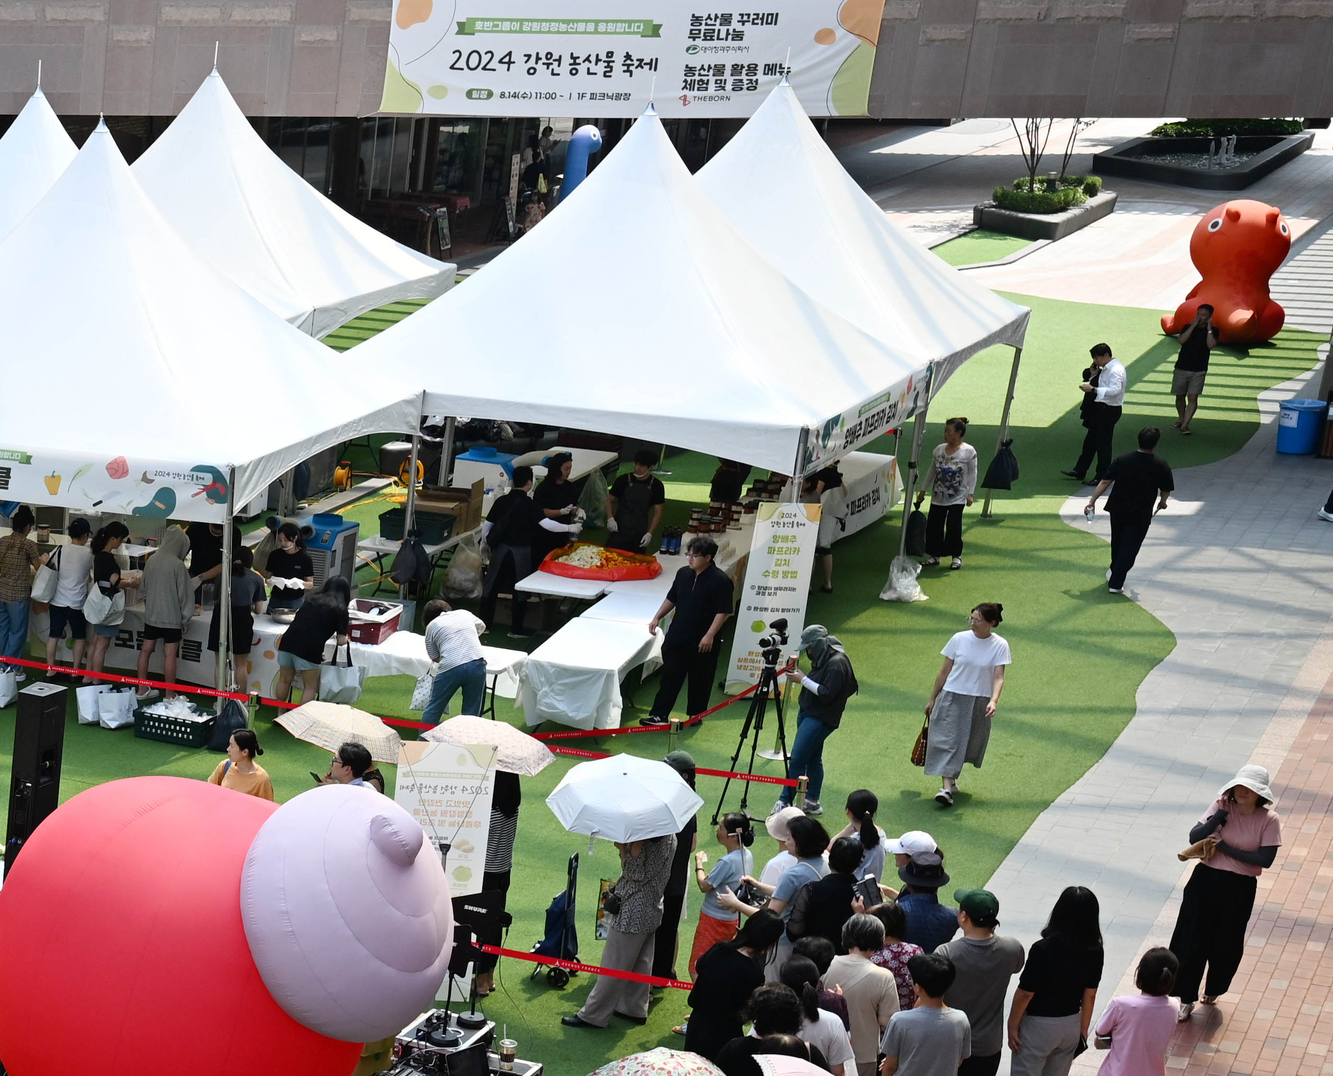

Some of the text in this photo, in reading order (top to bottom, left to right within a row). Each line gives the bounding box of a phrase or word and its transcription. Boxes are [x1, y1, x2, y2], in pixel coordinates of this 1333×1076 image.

[689, 12, 779, 27] 농산물 꾸러미
[474, 21, 644, 33] 호반그룹이 강원청정농산물을 응원합니다
[687, 28, 745, 42] 무료나눔
[449, 49, 658, 78] 2024 강원 농산물 축제
[683, 63, 727, 77] 농산물
[730, 63, 759, 77] 활용
[681, 78, 759, 92] 체험 및 증정
[471, 90, 489, 99] 일정
[499, 90, 533, 100] 8.14(수)
[534, 91, 557, 100] 11:00
[577, 92, 588, 101] 1F
[589, 92, 631, 101] 피크닉광장
[692, 95, 731, 103] THEBORN
[842, 420, 863, 450] 양배추
[862, 409, 887, 437] 파프리카
[885, 400, 899, 426] 김치
[154, 469, 171, 478] 2024
[772, 534, 798, 544] 양배추
[767, 546, 801, 556] 파프리카
[774, 558, 791, 567] 김치
[762, 569, 799, 579] 수령 방법
[561, 962, 582, 970] AVENUE
